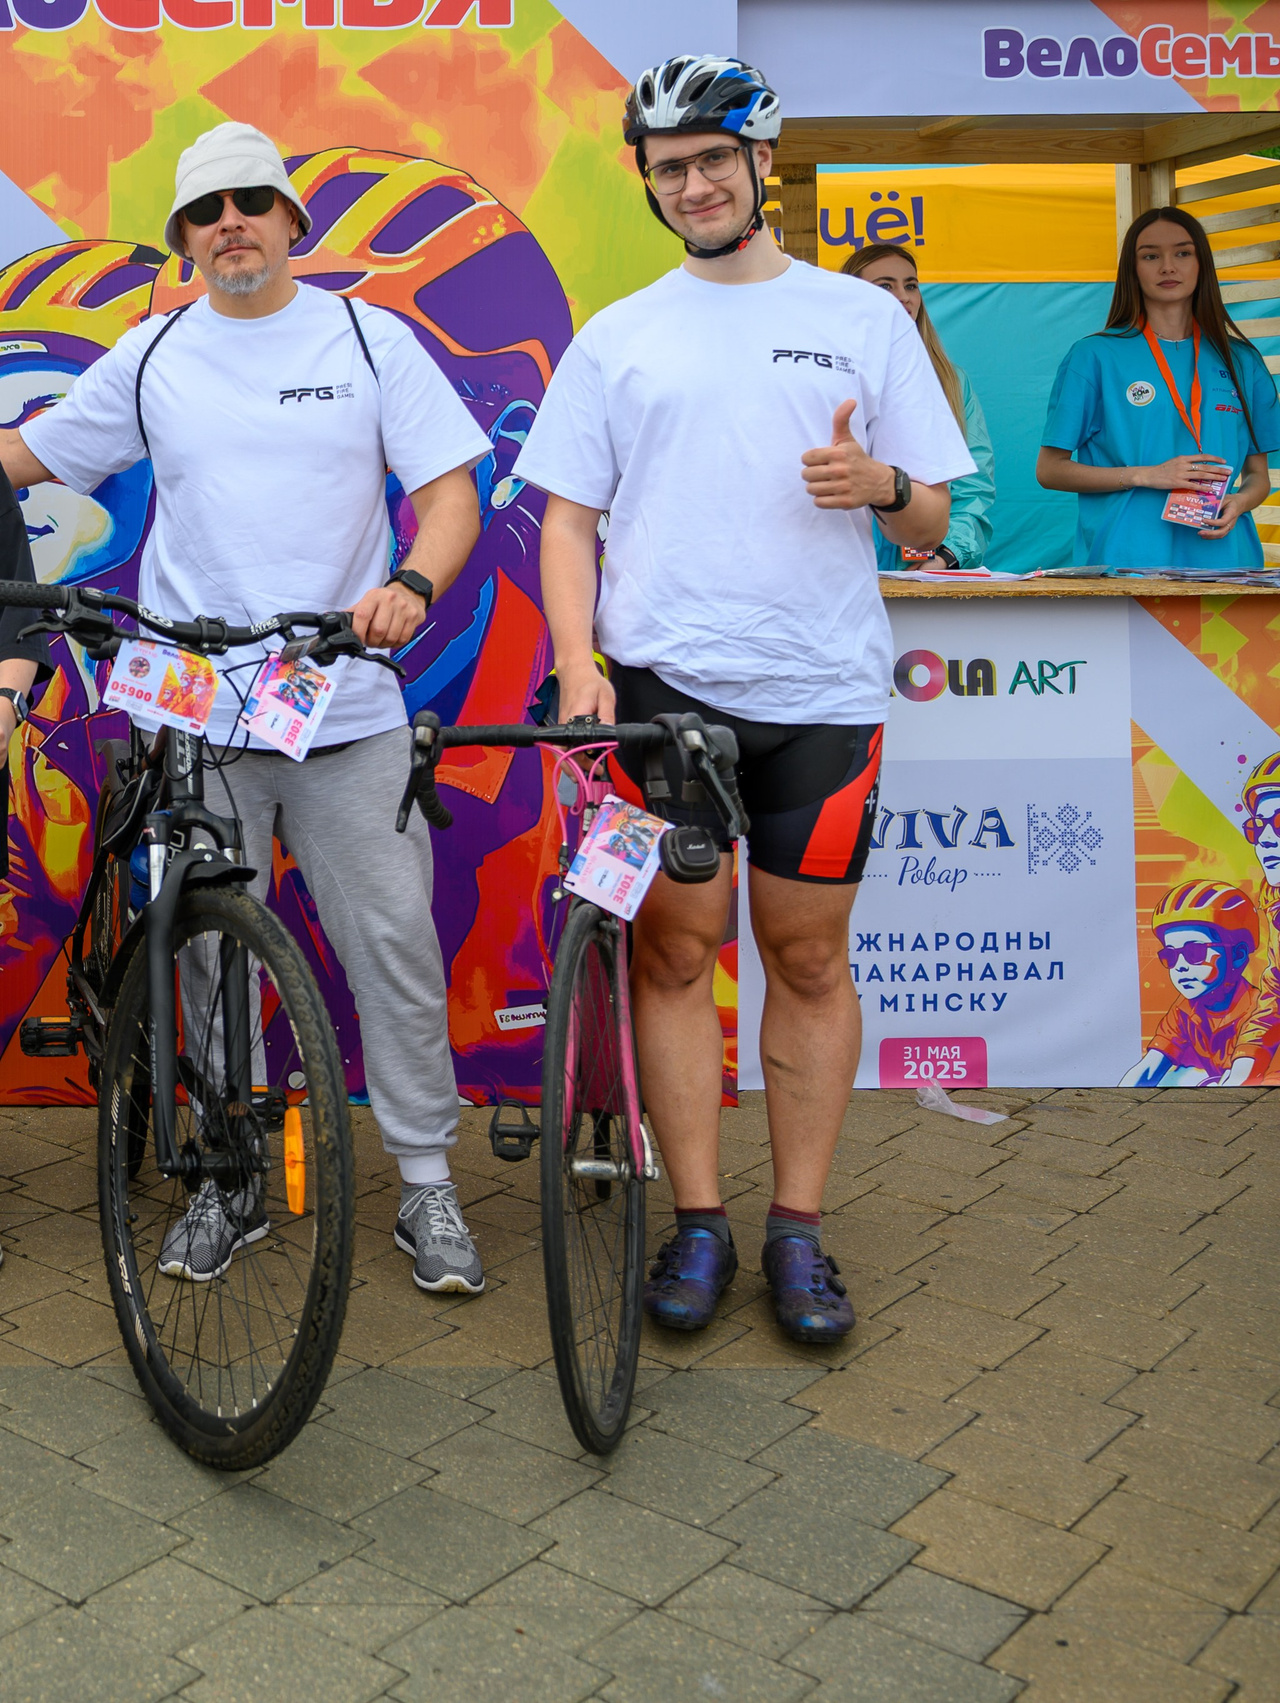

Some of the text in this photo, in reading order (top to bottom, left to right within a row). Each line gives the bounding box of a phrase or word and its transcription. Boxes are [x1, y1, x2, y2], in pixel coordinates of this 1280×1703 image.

[819, 191, 925, 252] цё!
[773, 349, 832, 368] PFG
[280, 386, 334, 405] PFG
[890, 649, 1088, 702] OLA ART
[111, 681, 152, 702] 05900
[284, 719, 303, 747] 3303
[869, 804, 1016, 850] VIVA
[897, 855, 968, 892] Ровар
[613, 873, 636, 904] 3301
[849, 931, 1050, 953] ЖНАРОДНЫ
[880, 992, 1007, 1013] МІНСКУ
[903, 1046, 961, 1059] 31 МАЯ
[903, 1061, 967, 1079] 2025
